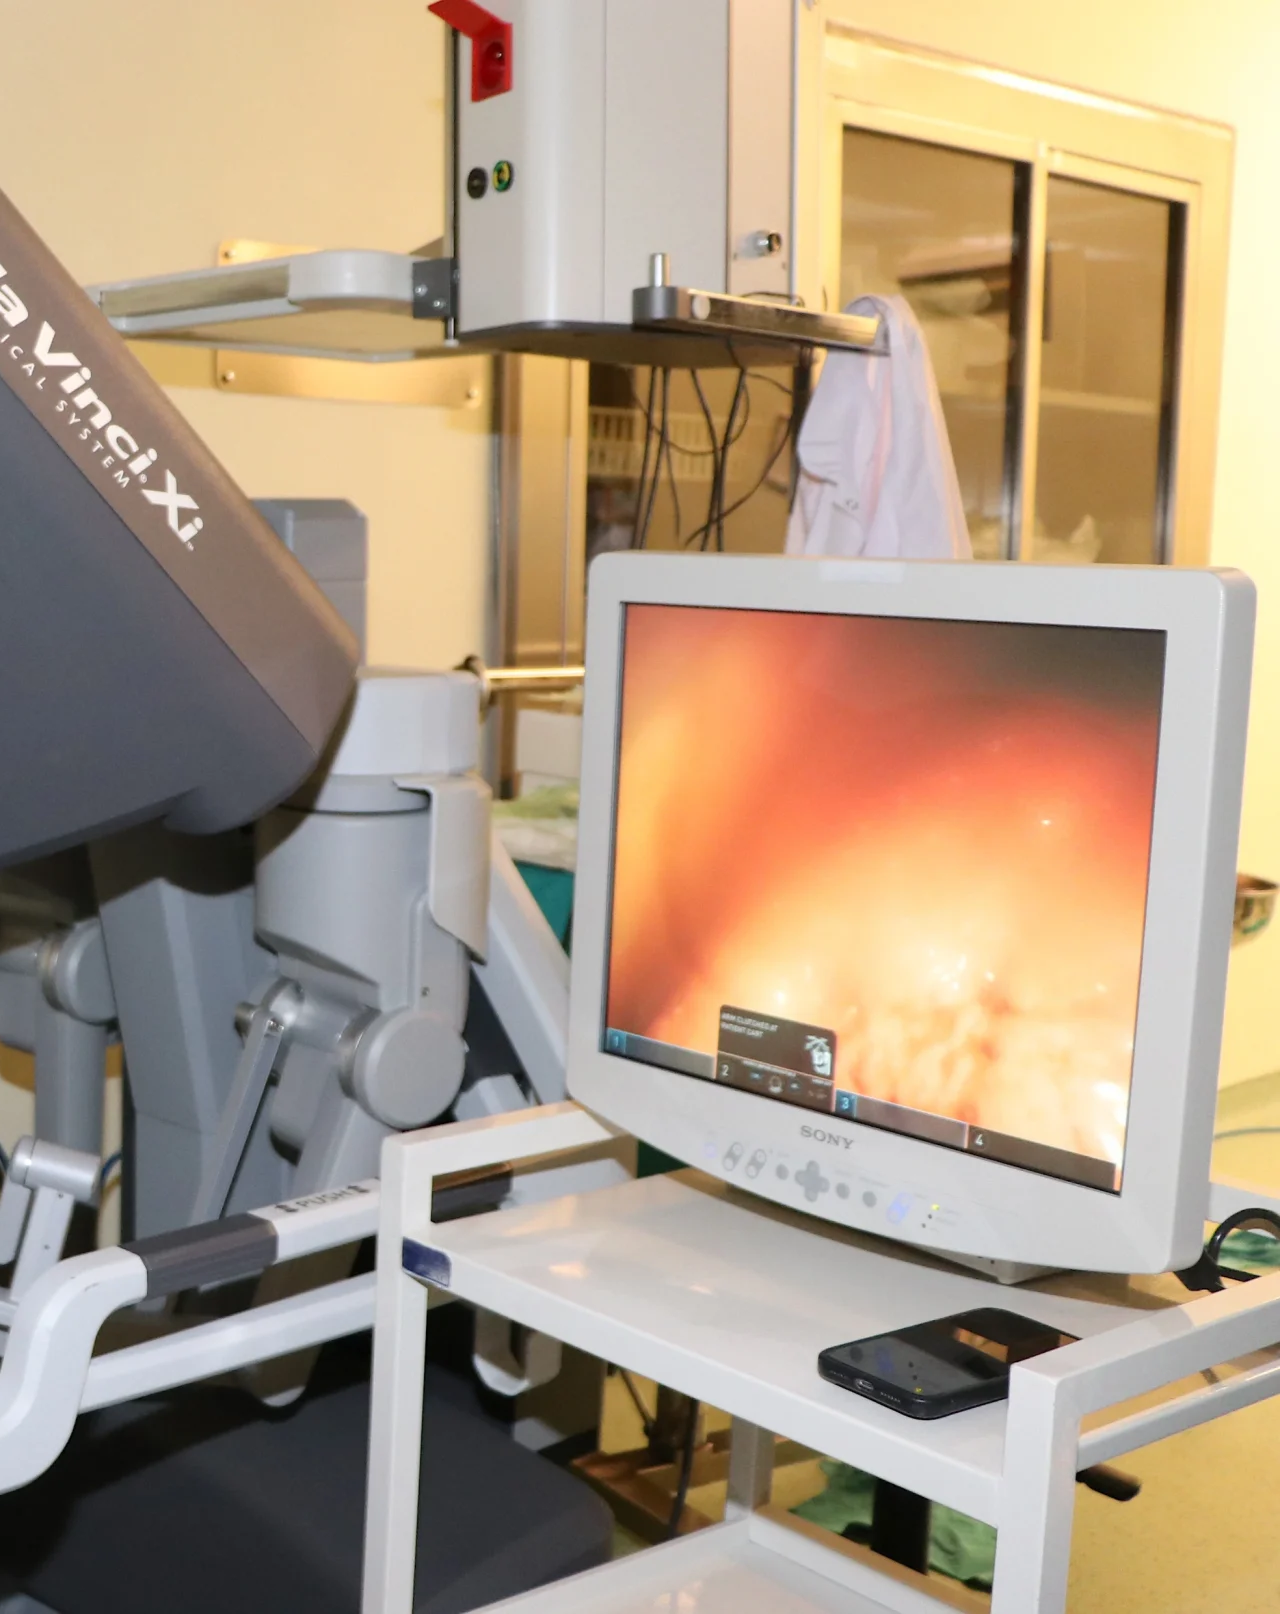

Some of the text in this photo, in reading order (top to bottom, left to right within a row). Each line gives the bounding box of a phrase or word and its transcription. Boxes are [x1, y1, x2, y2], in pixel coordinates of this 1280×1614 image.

[56, 399, 131, 489] SYSTEM
[721, 1063, 730, 1077] 2
[841, 1096, 850, 1110] 3
[799, 1124, 855, 1150] SONY
[974, 1133, 984, 1147] 4
[295, 1188, 353, 1209] PUSH
